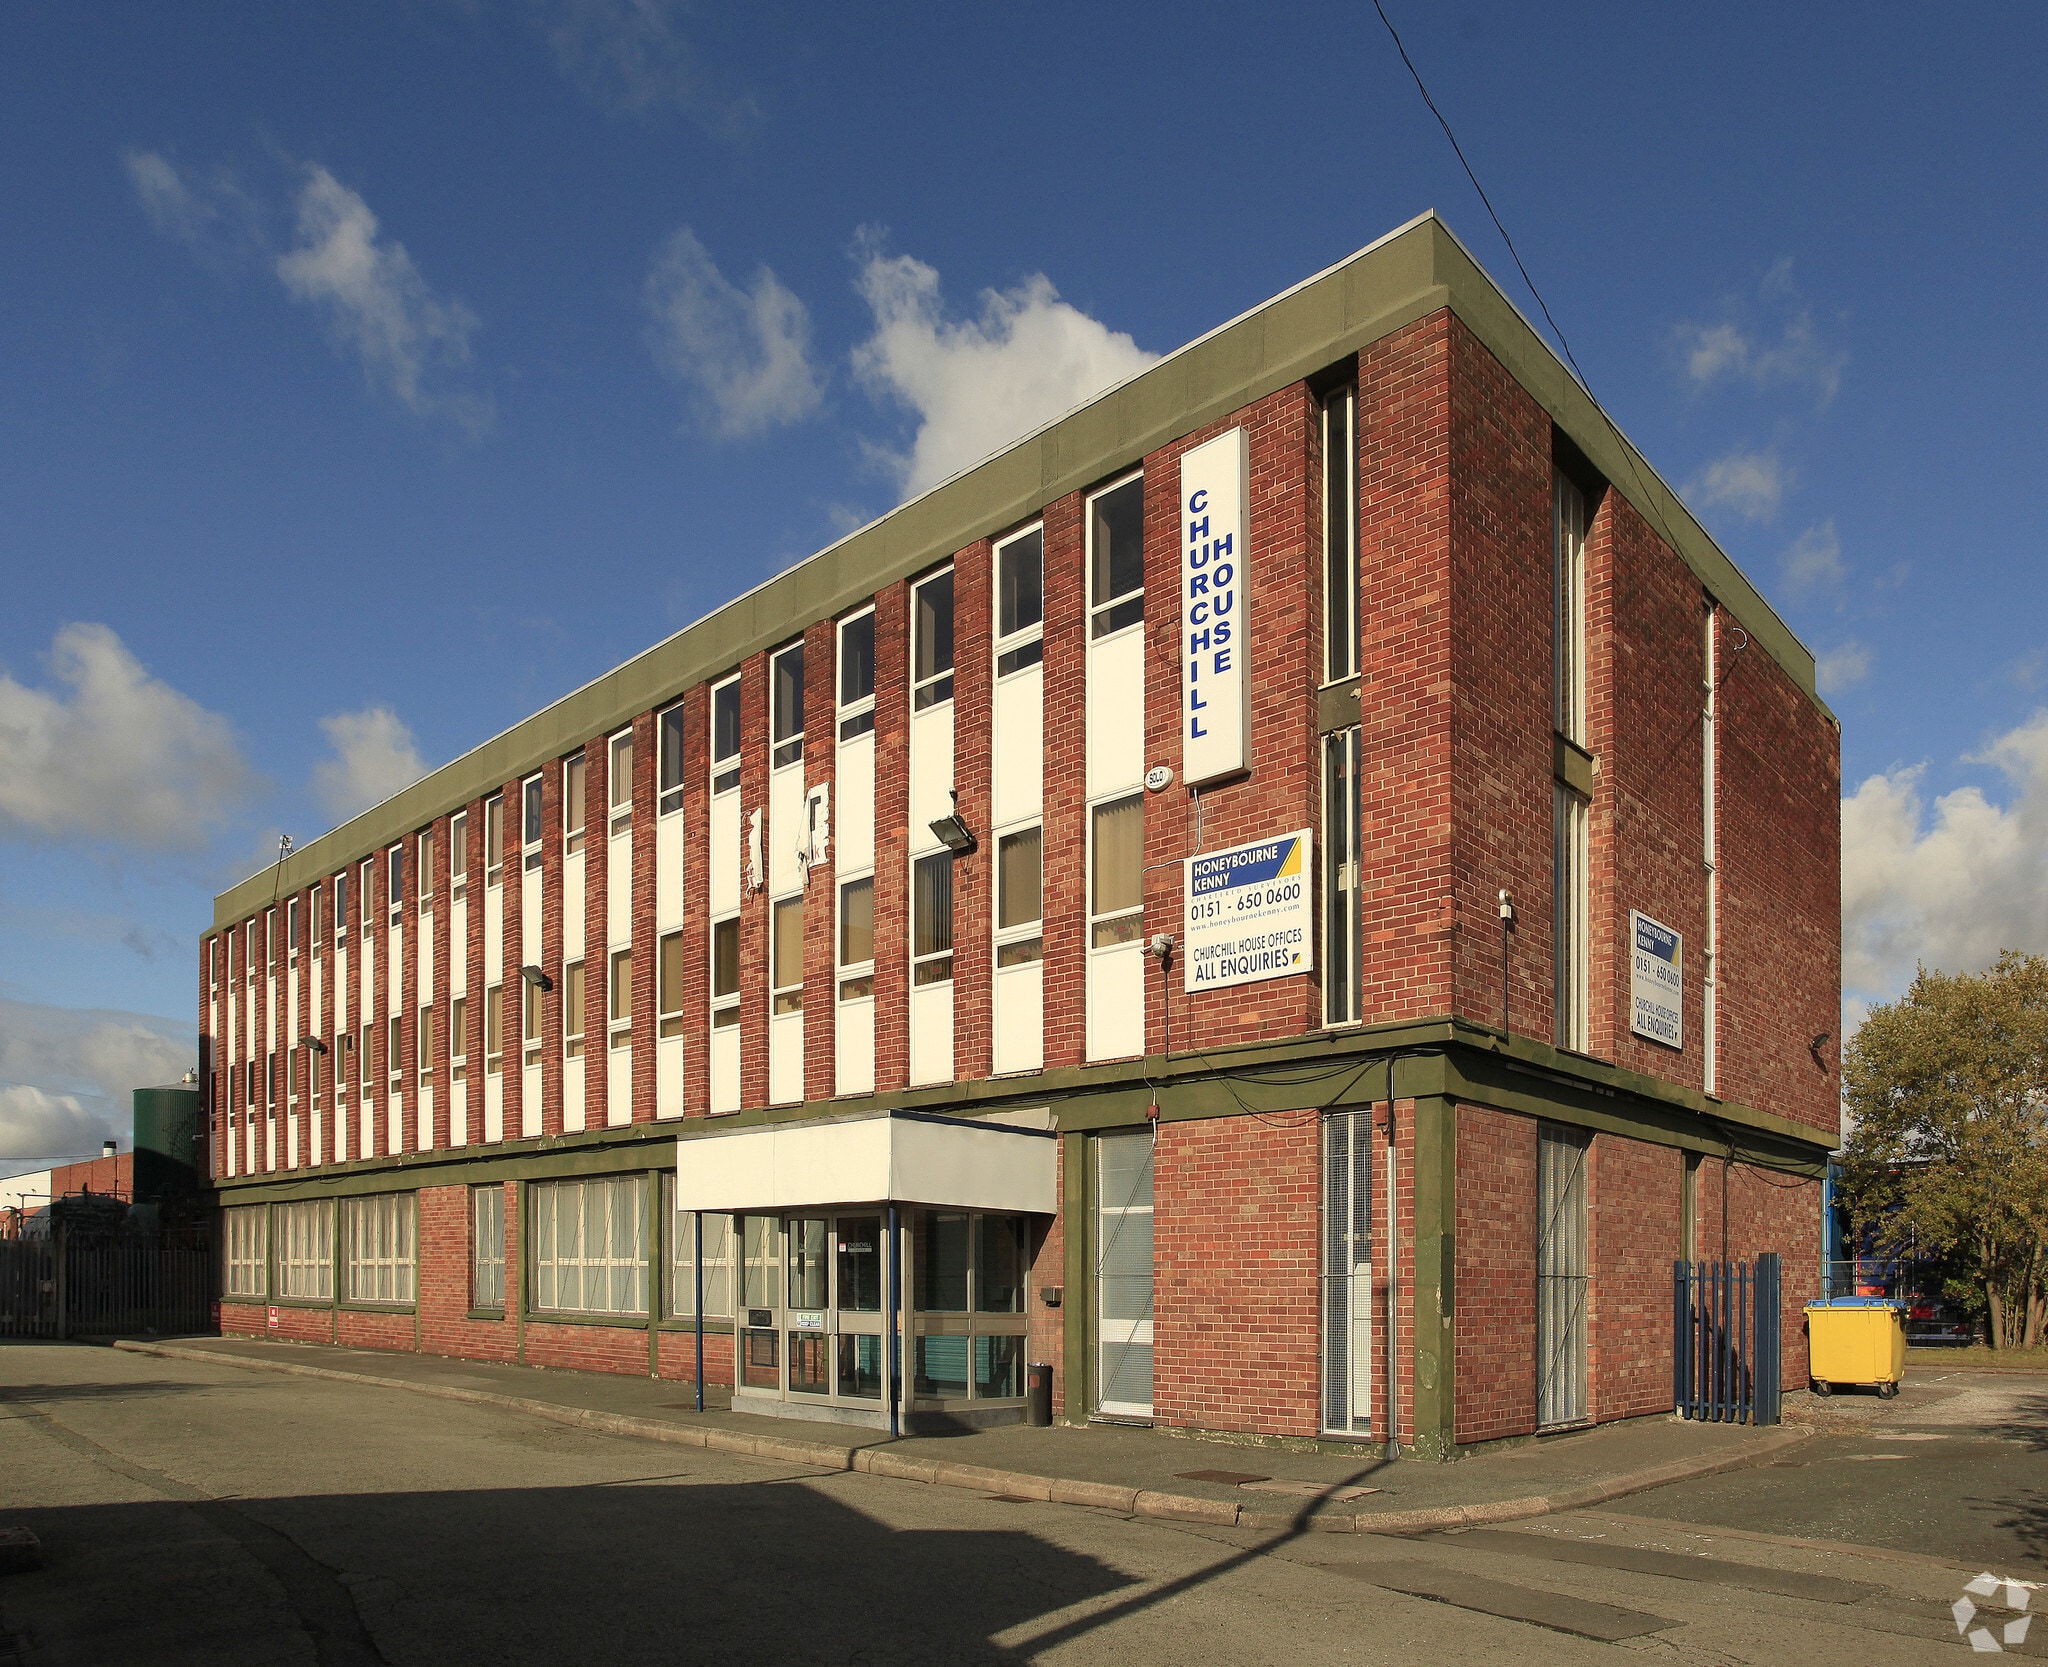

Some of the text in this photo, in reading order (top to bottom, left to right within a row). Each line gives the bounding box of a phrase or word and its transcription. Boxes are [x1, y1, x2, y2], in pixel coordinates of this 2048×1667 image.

[1189, 489, 1209, 739] CHURCHILL
[1212, 533, 1233, 675] HOUSE
[1194, 845, 1278, 877] HONEYBOURNE
[1191, 875, 1302, 904] CHARTERED SURVEYORS
[1194, 872, 1231, 893] KENNY
[1191, 900, 1221, 921] 0151
[1237, 892, 1262, 911] 650
[1266, 883, 1301, 905] 0600
[1190, 904, 1300, 932] www.honeybournekenny.com
[1637, 920, 1672, 947] HONEYBOURNE
[1193, 928, 1302, 962] CHURCHILL HOUSE OFFICES
[1637, 934, 1655, 951] KENNY
[1195, 948, 1289, 982] ALL ENQUIRIES
[1635, 956, 1650, 974] 0151
[1656, 965, 1666, 981] 650
[1667, 970, 1679, 987] 0600
[1636, 1012, 1674, 1040] ALL ENQUIRIES
